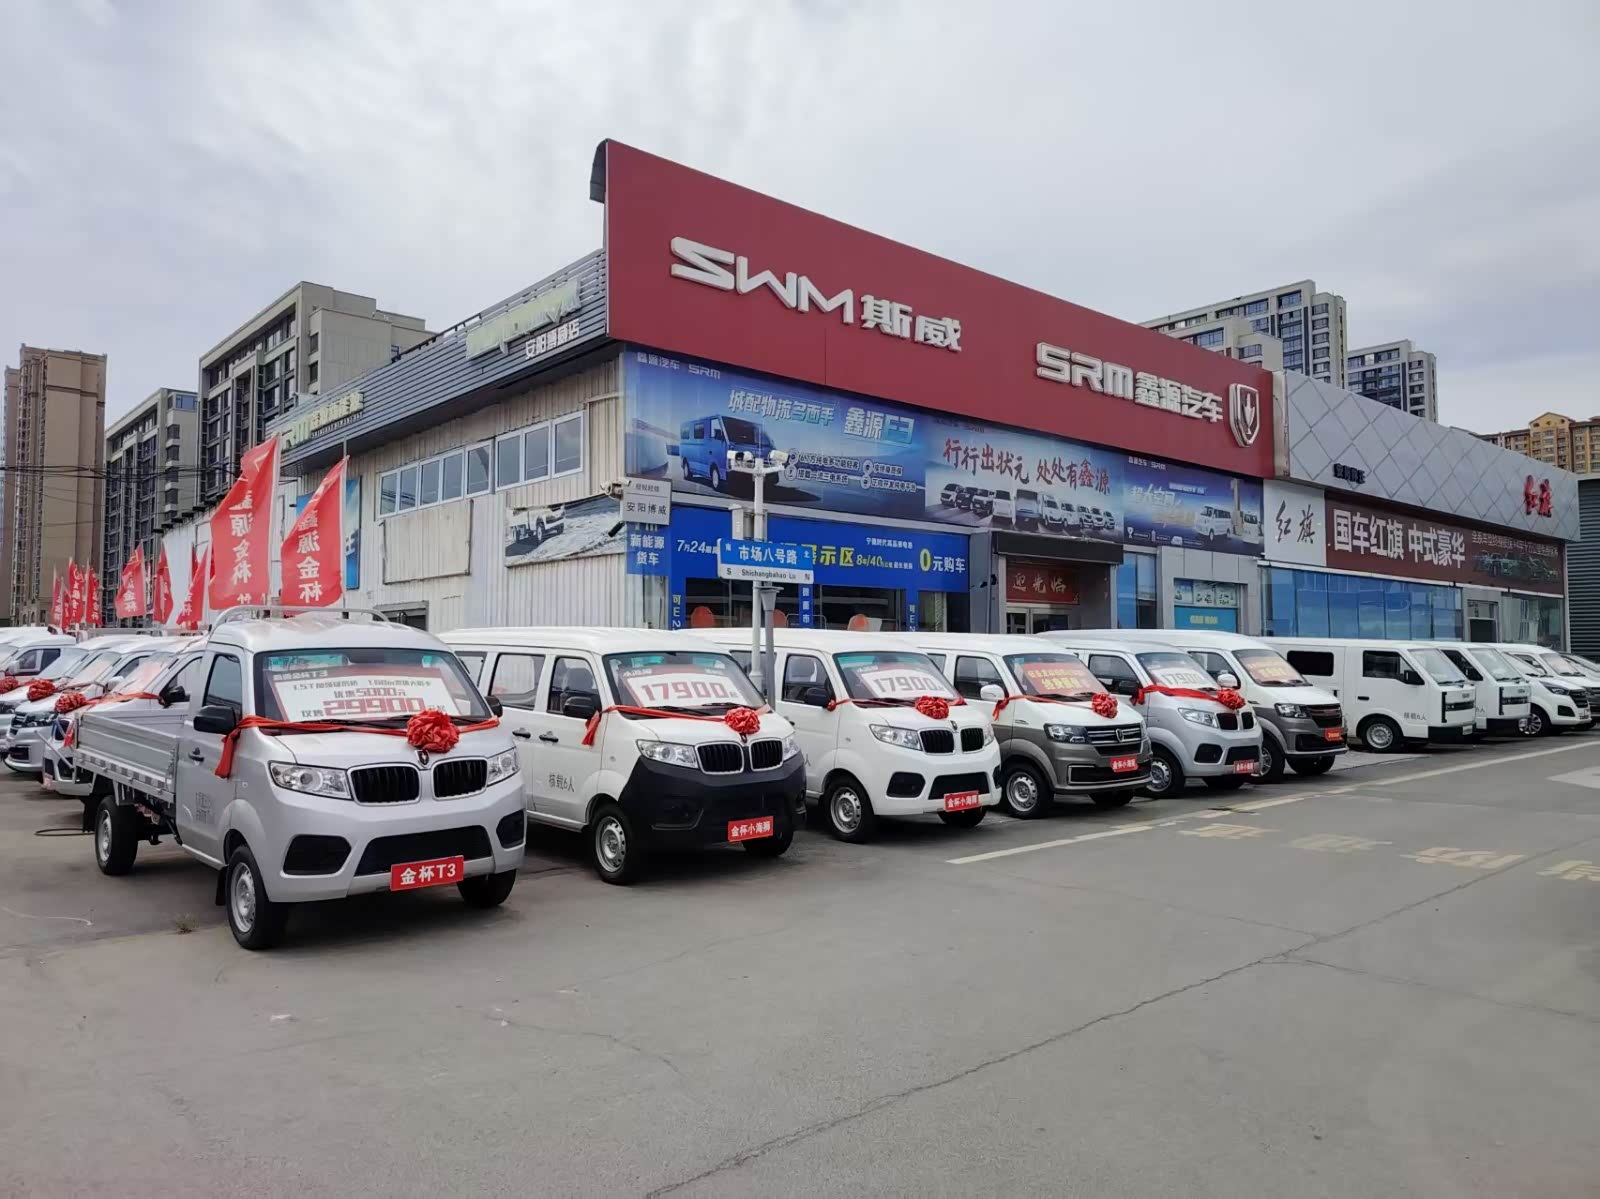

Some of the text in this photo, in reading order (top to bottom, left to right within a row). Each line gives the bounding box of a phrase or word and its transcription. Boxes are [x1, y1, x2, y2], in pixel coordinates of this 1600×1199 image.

[671, 237, 962, 352] SWM 斯威
[688, 364, 721, 379] SRM
[1036, 342, 1224, 423] SRM 鑫源汽车
[728, 389, 834, 426] 城配物流多面手
[943, 438, 1111, 496] 行行出状元 处处有鑫源
[627, 502, 667, 516] 安阳博威
[1276, 500, 1315, 544] 红旗
[630, 534, 665, 549] 新能源
[1334, 509, 1404, 560] 国车红旗
[1408, 523, 1465, 569] 中式豪华
[637, 551, 659, 565] 货车
[738, 545, 798, 565] 市场八号路
[727, 568, 732, 576] S
[789, 571, 797, 579] Lu
[641, 681, 728, 701] 17900
[873, 676, 938, 693] 17900
[731, 820, 771, 838] 金杯小海狮
[400, 863, 456, 886] 金杯T3
